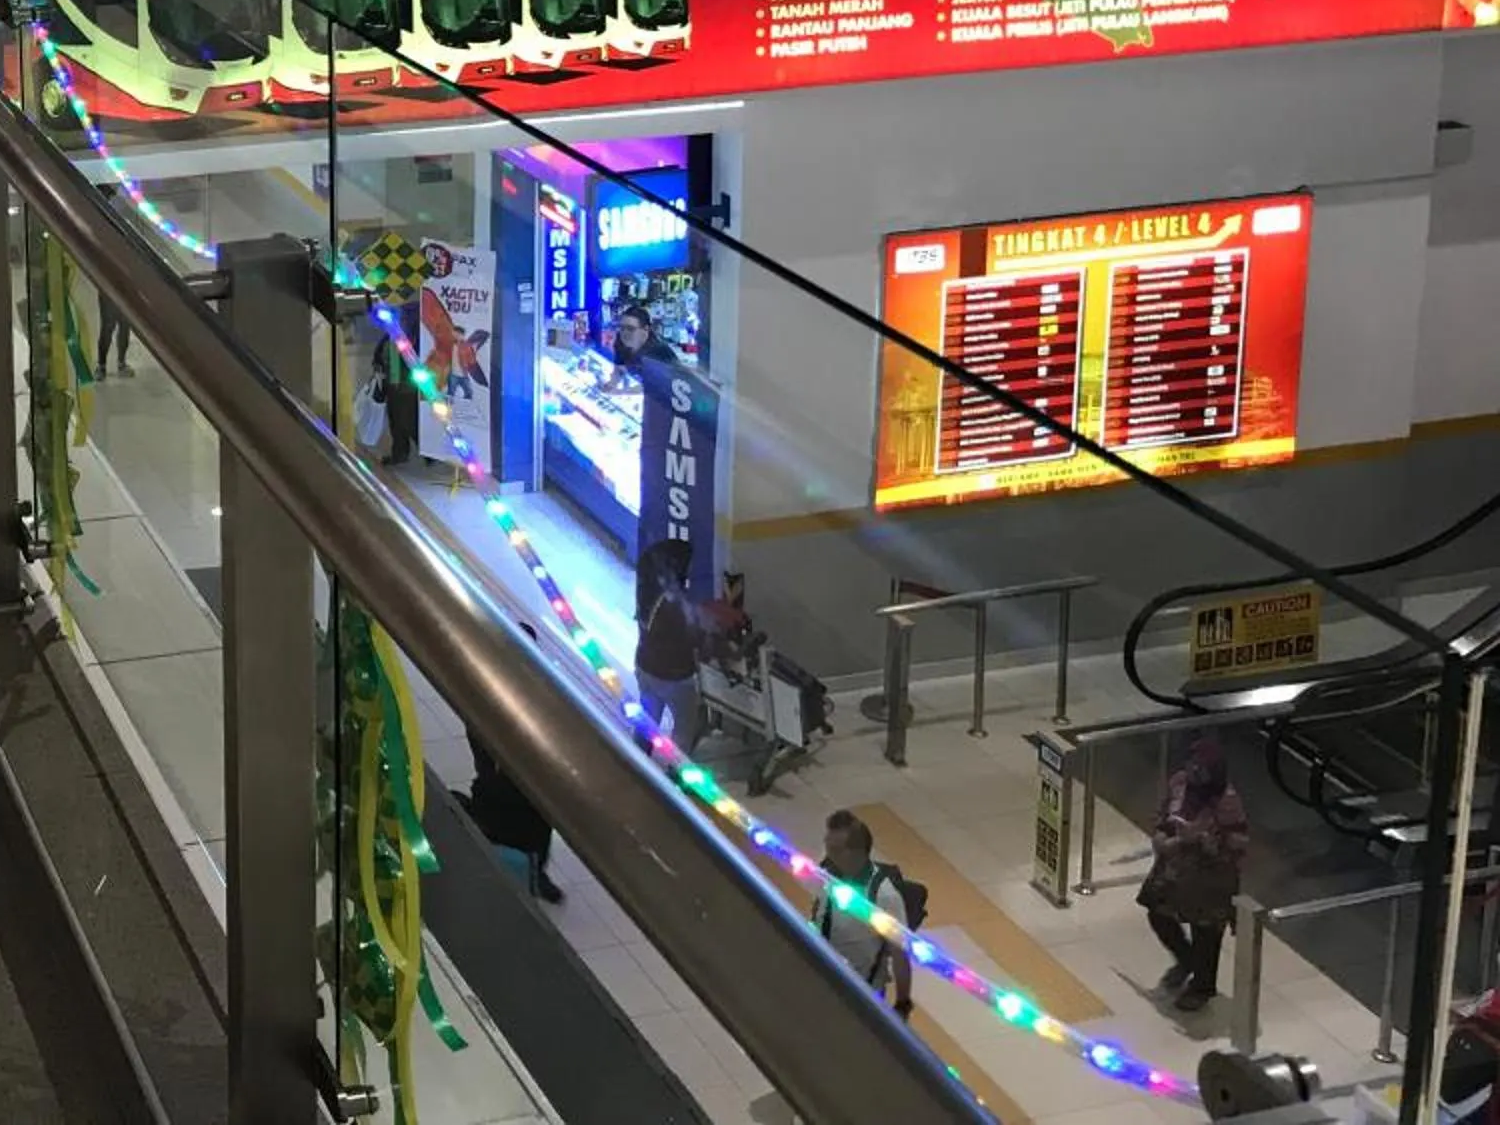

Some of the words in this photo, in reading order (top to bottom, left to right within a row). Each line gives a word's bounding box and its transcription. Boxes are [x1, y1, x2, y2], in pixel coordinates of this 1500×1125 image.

[770, 3, 824, 20] TANAH
[951, 6, 1002, 24] KUALA
[770, 20, 834, 39] RANTAU
[994, 227, 1086, 256] TINGKAT
[1093, 223, 1107, 246] 4
[1131, 214, 1190, 242] LEVEL
[1197, 211, 1211, 234] 4
[441, 285, 489, 302] XACTLY
[1246, 594, 1309, 616] CAUTION
